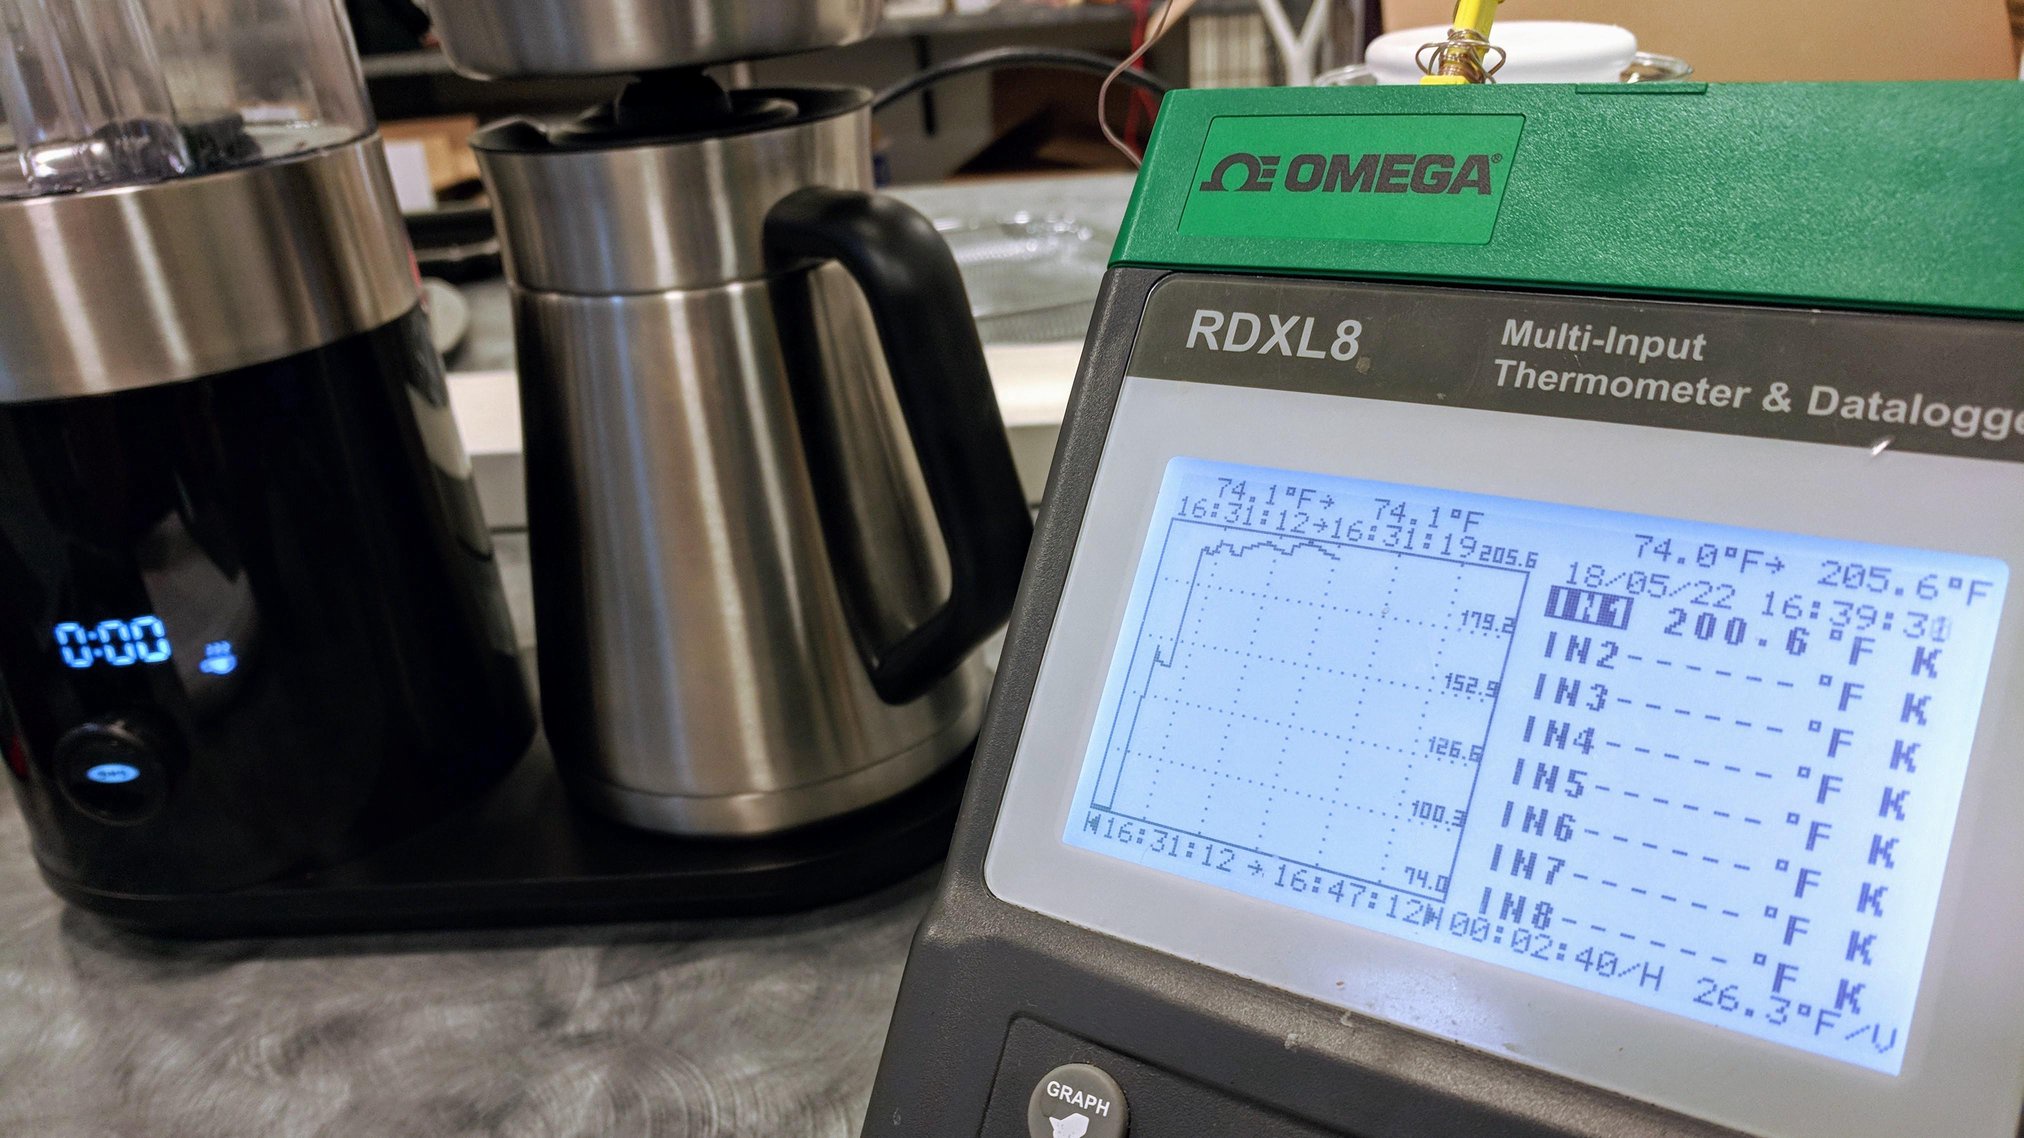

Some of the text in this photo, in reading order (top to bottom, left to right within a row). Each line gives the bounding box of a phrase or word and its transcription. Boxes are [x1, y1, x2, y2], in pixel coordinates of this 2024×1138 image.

[1284, 153, 1492, 195] OMEGA
[1185, 309, 1362, 363] RDXL8
[1501, 318, 1706, 365] Multi-Input
[1494, 359, 1753, 412] Thermometer
[1761, 382, 1792, 414] &
[1478, 546, 1539, 569] 205.6
[1565, 561, 1736, 610] 18/05/22
[1461, 610, 1516, 635] 179.2
[53, 614, 172, 669] 0:00
[1911, 646, 1943, 680] K
[1900, 692, 1932, 726] K
[1889, 739, 1921, 774] K
[1878, 786, 1911, 822] K
[1867, 834, 1899, 869] K
[1856, 882, 1889, 918] K
[1845, 930, 1878, 966] K
[1834, 979, 1869, 1015] K
[1046, 1080, 1111, 1117] GRAPH
